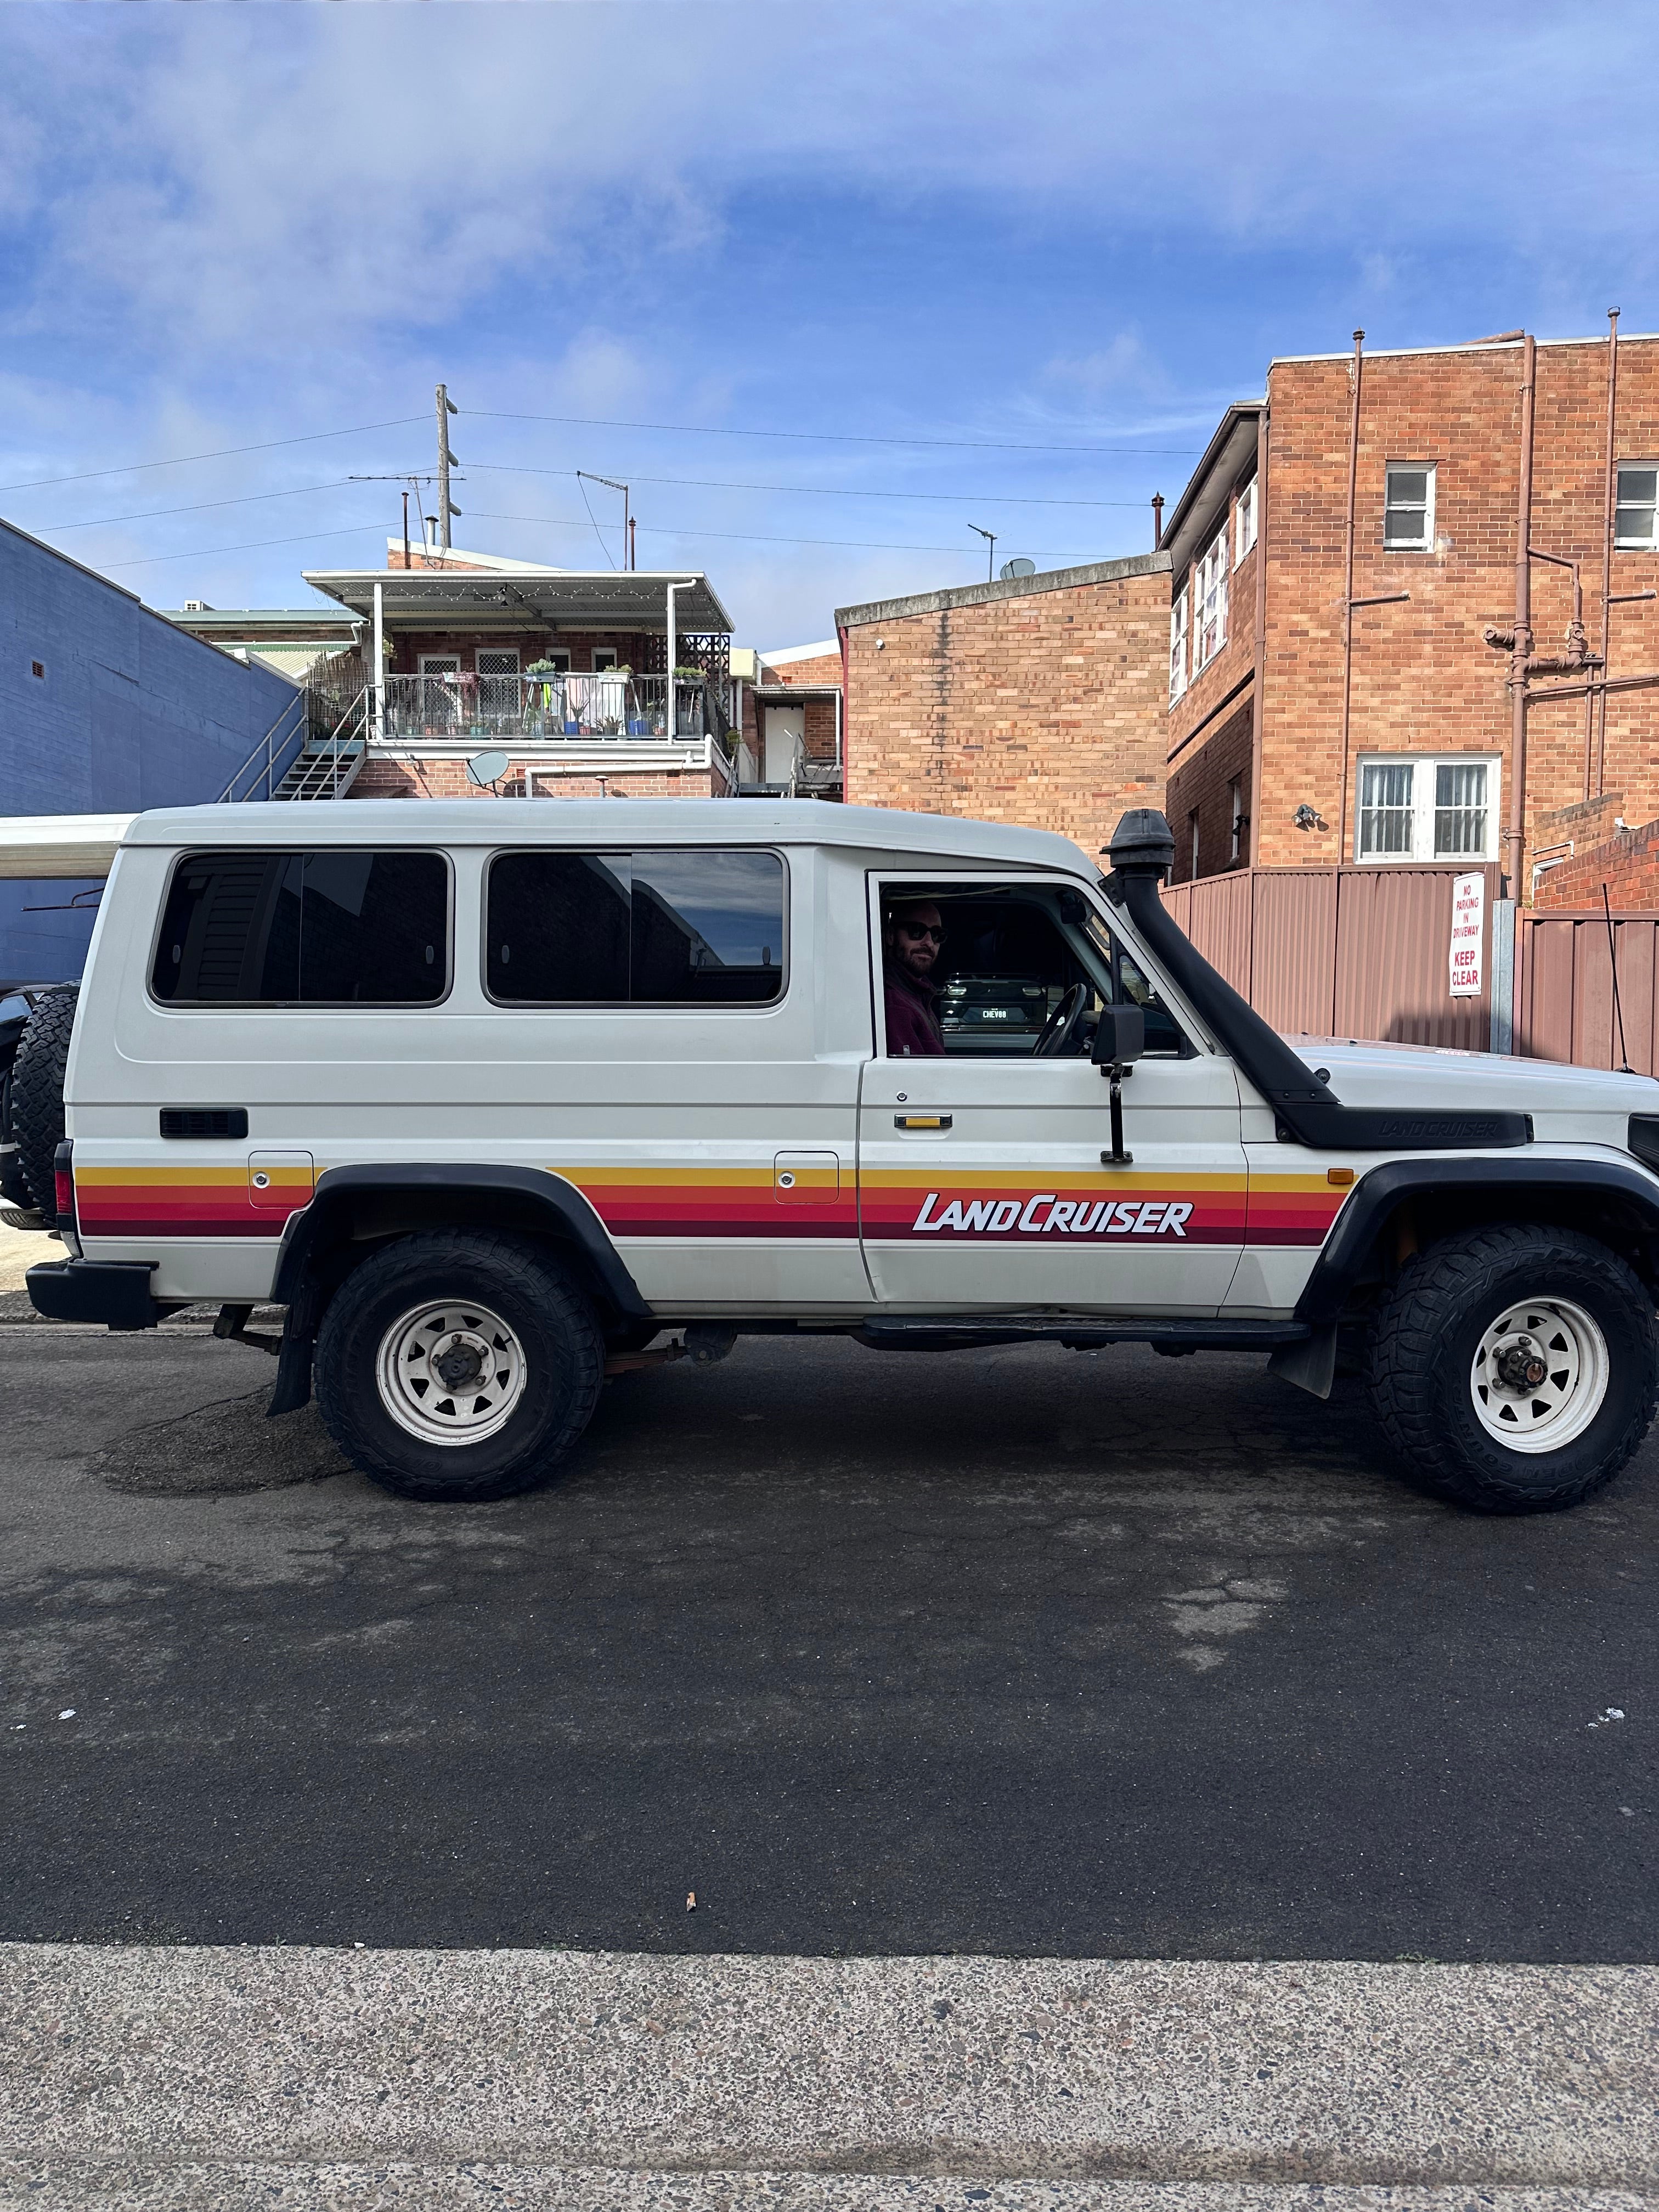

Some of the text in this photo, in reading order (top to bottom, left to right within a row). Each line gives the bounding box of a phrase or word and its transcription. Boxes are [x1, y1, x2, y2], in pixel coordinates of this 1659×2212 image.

[1464, 885, 1471, 896] NO
[1457, 898, 1479, 911] PARKING
[1464, 912, 1469, 923] IN
[1453, 925, 1479, 938] DRIVEWAY
[1455, 951, 1475, 966] KEEP
[1453, 970, 1478, 985] CLEAR
